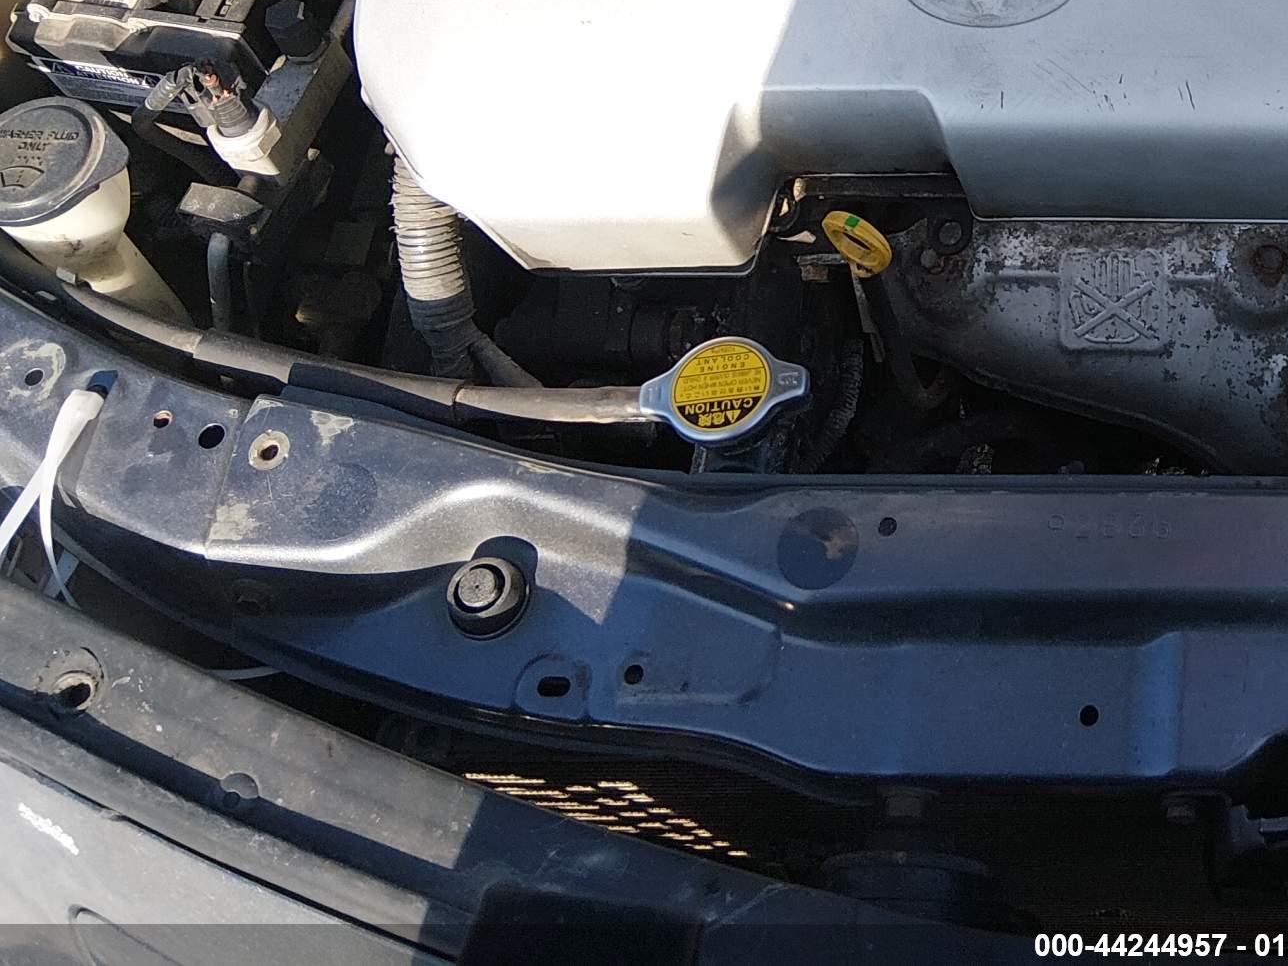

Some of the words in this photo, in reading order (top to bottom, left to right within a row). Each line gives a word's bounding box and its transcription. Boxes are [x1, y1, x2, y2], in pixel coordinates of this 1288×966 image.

[47, 130, 79, 140] FLUID
[18, 142, 51, 151] ONLY
[697, 354, 750, 366] COOLANT
[700, 362, 745, 372] ENGINE
[738, 377, 761, 385] NEVER
[685, 398, 754, 415] CAUTION
